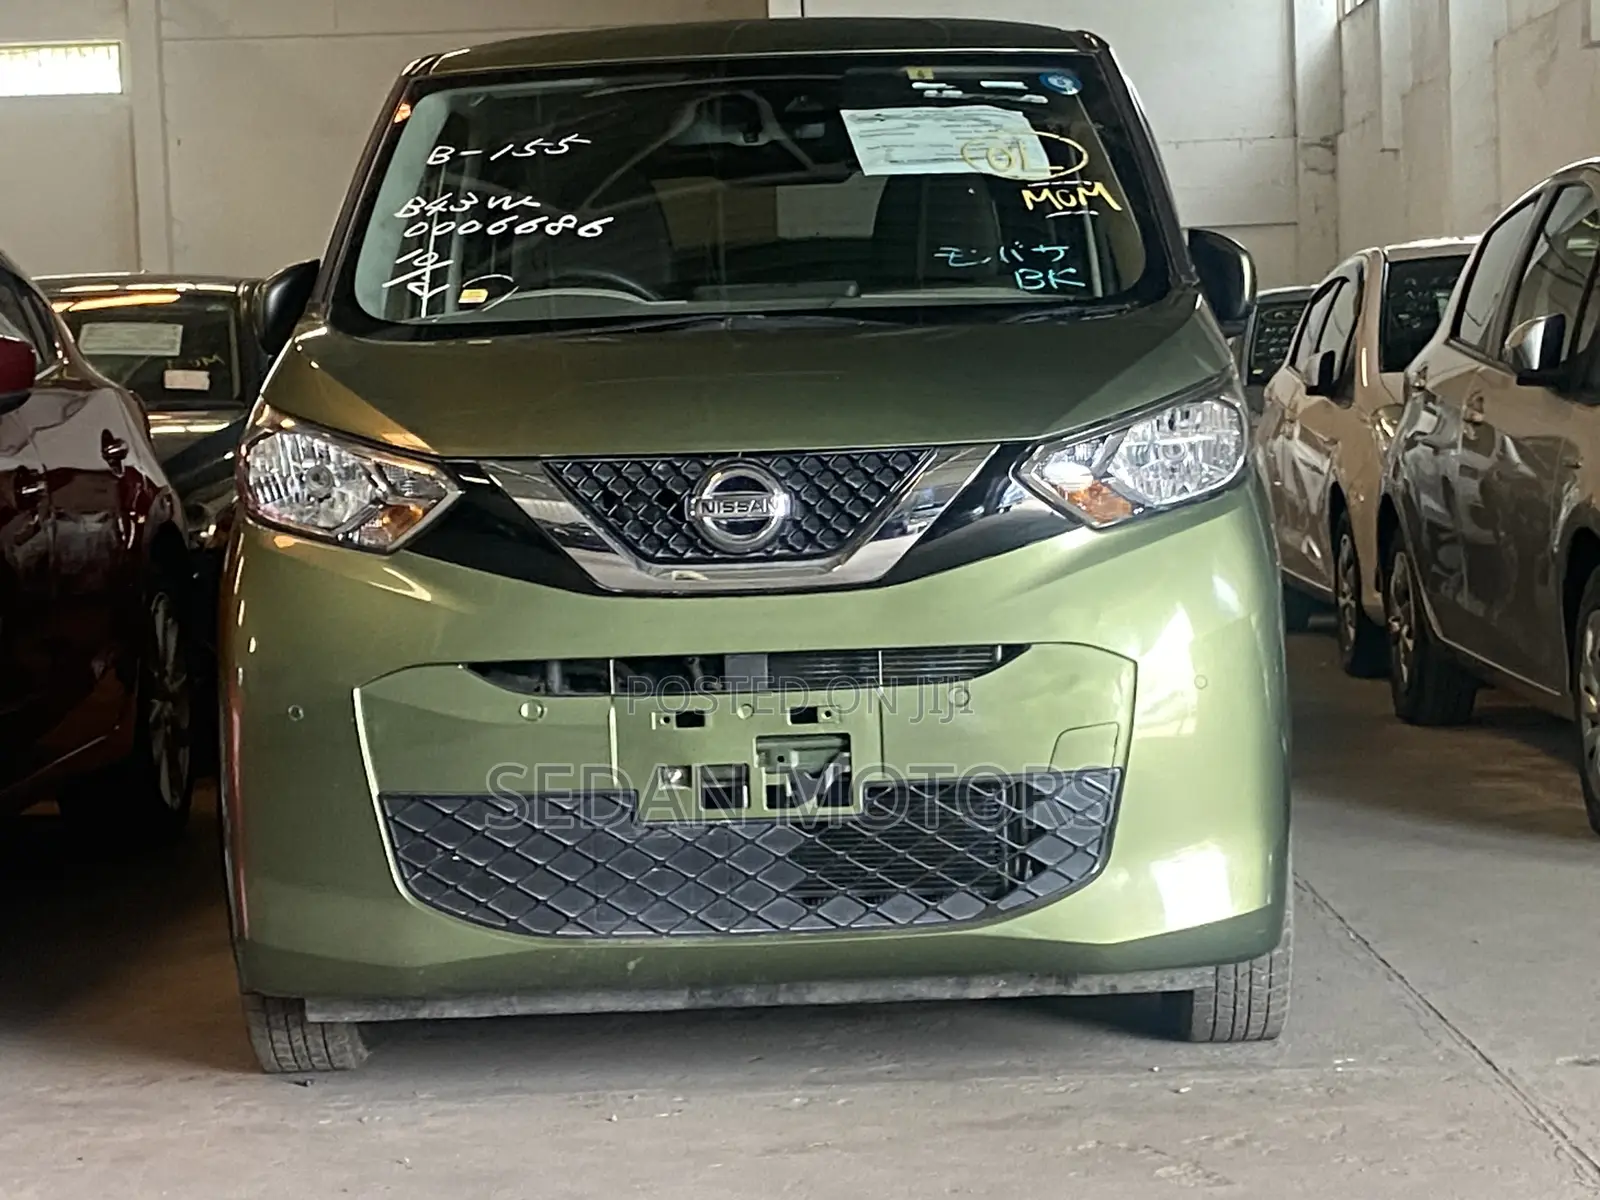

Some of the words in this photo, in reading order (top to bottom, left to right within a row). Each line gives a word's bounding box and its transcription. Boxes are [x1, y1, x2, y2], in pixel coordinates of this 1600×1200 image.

[426, 133, 592, 165] B-155
[1021, 181, 1123, 212] MOM
[1014, 267, 1086, 290] BK
[700, 499, 781, 514] NISSAN
